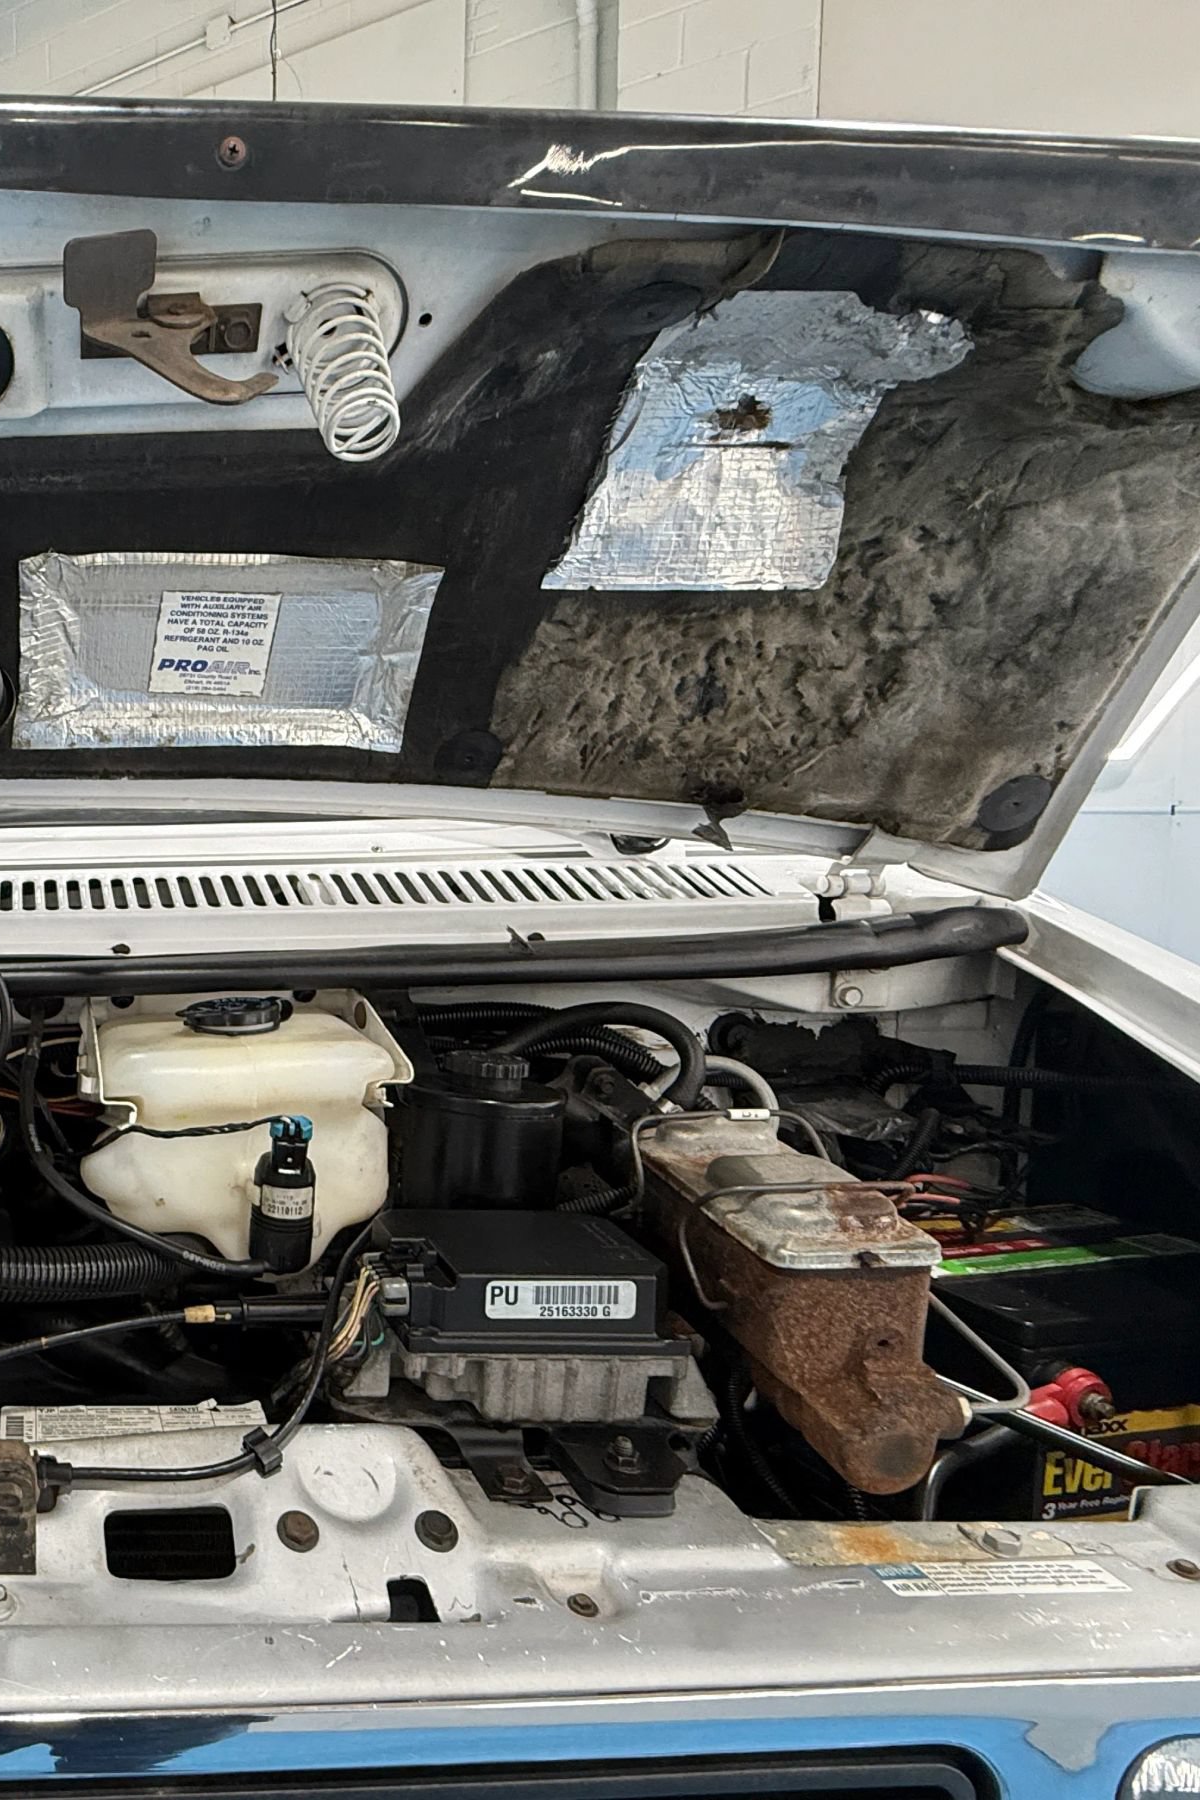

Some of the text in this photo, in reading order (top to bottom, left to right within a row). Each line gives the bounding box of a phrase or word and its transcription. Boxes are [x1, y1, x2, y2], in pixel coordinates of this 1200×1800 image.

[223, 596, 265, 604] EQUIPPED
[203, 603, 245, 611] AUXILIARY
[170, 610, 229, 619] CONDITIONING
[200, 619, 225, 627] TOTAL
[227, 620, 268, 629] CAPACITY
[163, 635, 221, 644] REFRIGERANT
[222, 637, 240, 645] AND
[490, 1285, 519, 1306] PU
[540, 1306, 611, 1317] 25163330 G
[1041, 1502, 1057, 1520] 3
[1058, 1501, 1079, 1511] Year
[1080, 1499, 1100, 1509] Free
[892, 1583, 915, 1591] AIR
[912, 1582, 940, 1591] BAG
